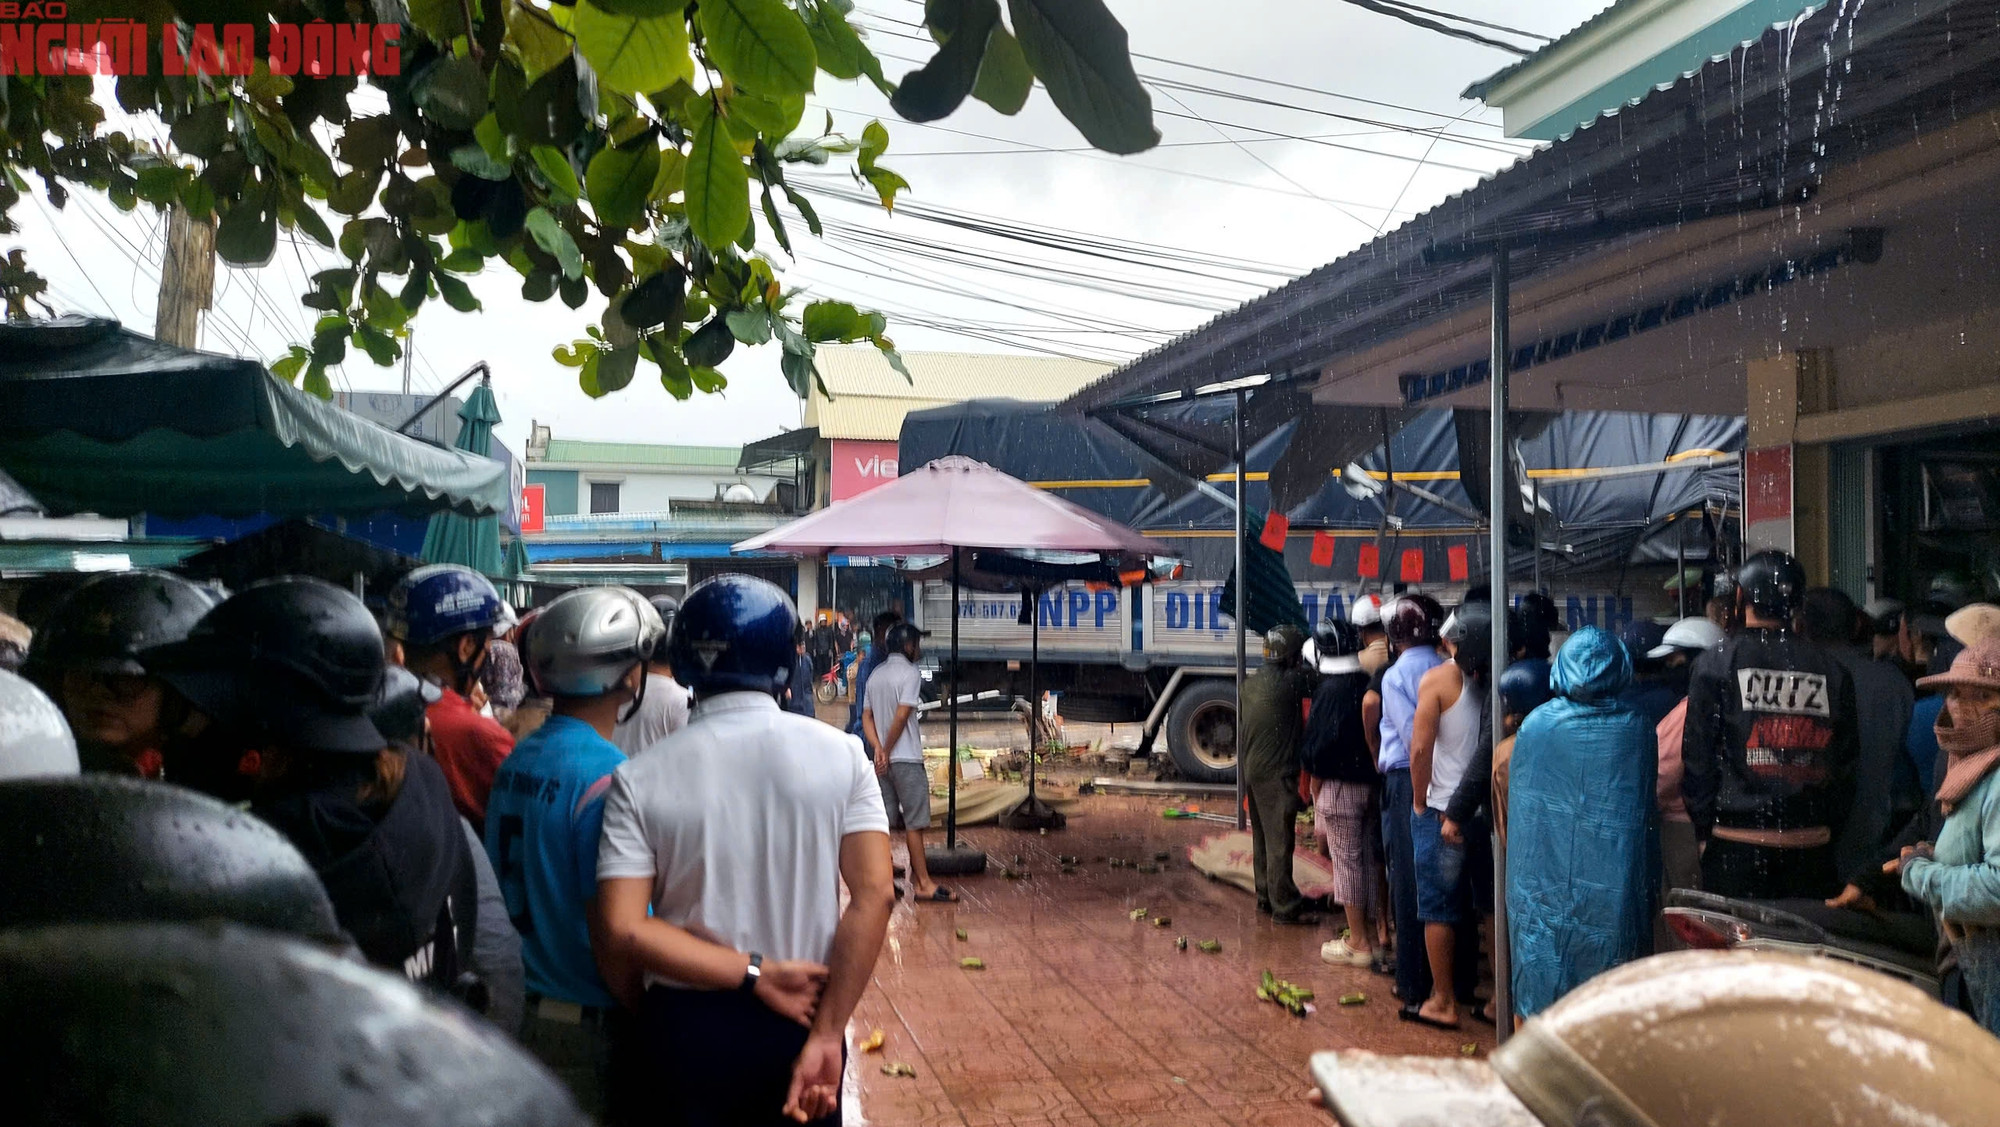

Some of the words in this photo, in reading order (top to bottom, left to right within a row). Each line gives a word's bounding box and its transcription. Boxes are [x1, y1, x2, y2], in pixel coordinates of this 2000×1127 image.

[854, 455, 899, 478] vie
[1039, 590, 1117, 628] NPP
[1165, 586, 1230, 641] ĐIỆ
